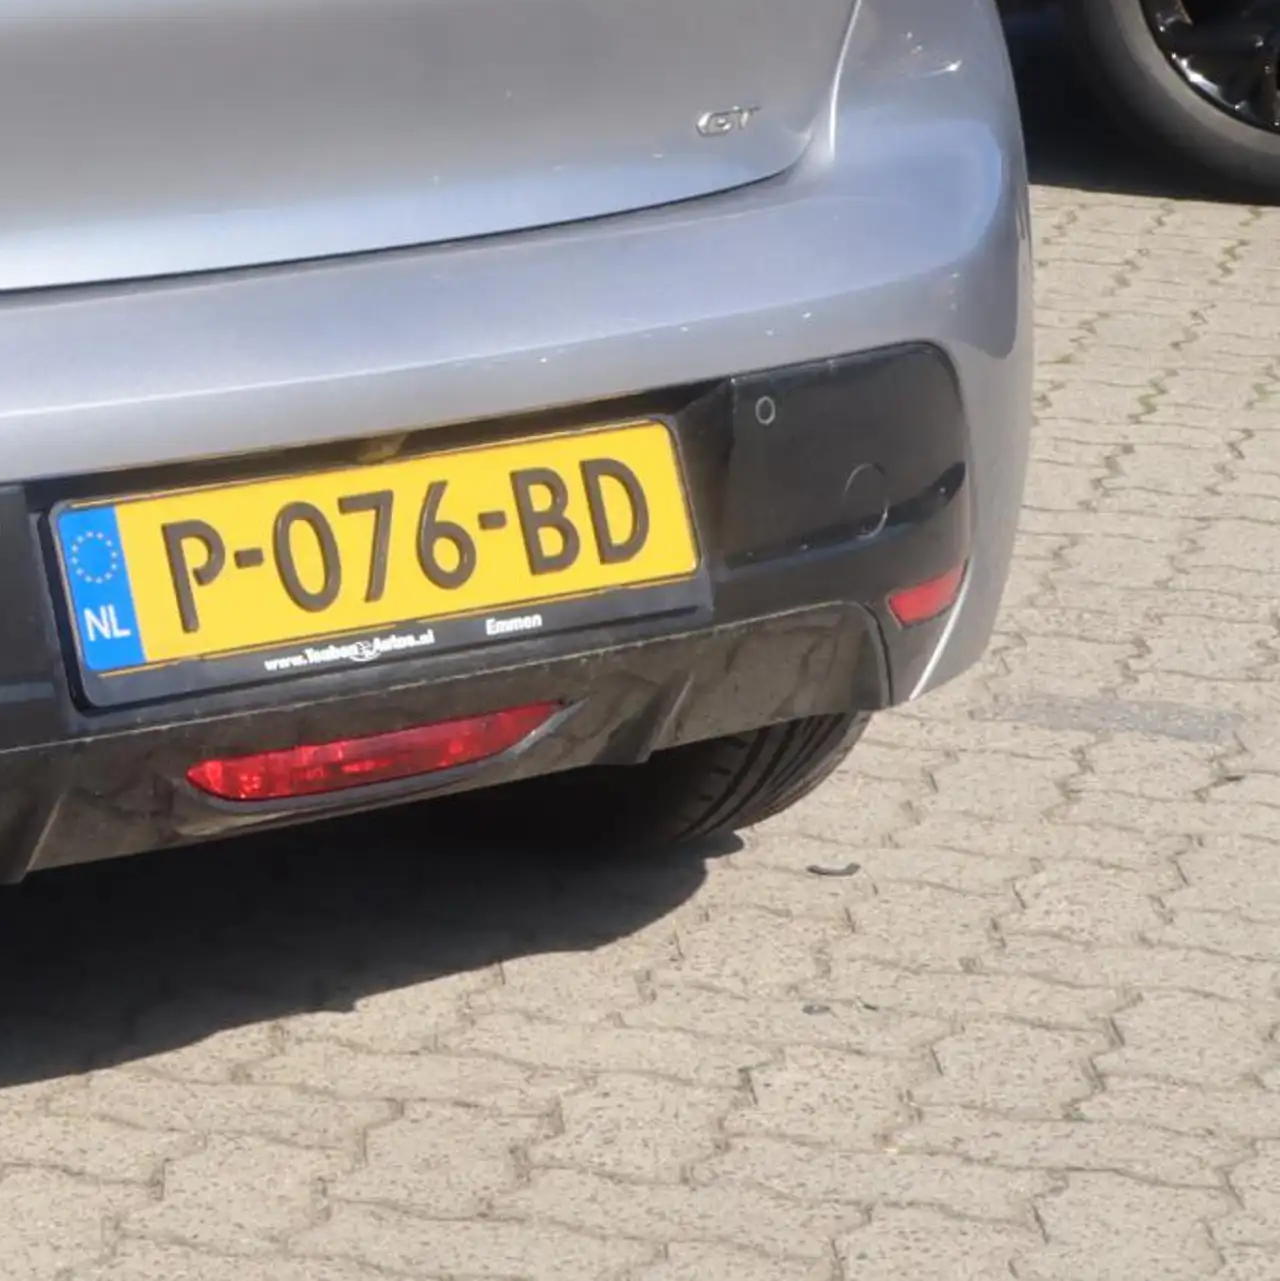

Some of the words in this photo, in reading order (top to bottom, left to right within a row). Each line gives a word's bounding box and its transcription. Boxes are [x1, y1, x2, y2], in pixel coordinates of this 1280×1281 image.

[695, 106, 761, 137] GT
[161, 456, 651, 635] P-076-BD
[83, 603, 132, 643] NL
